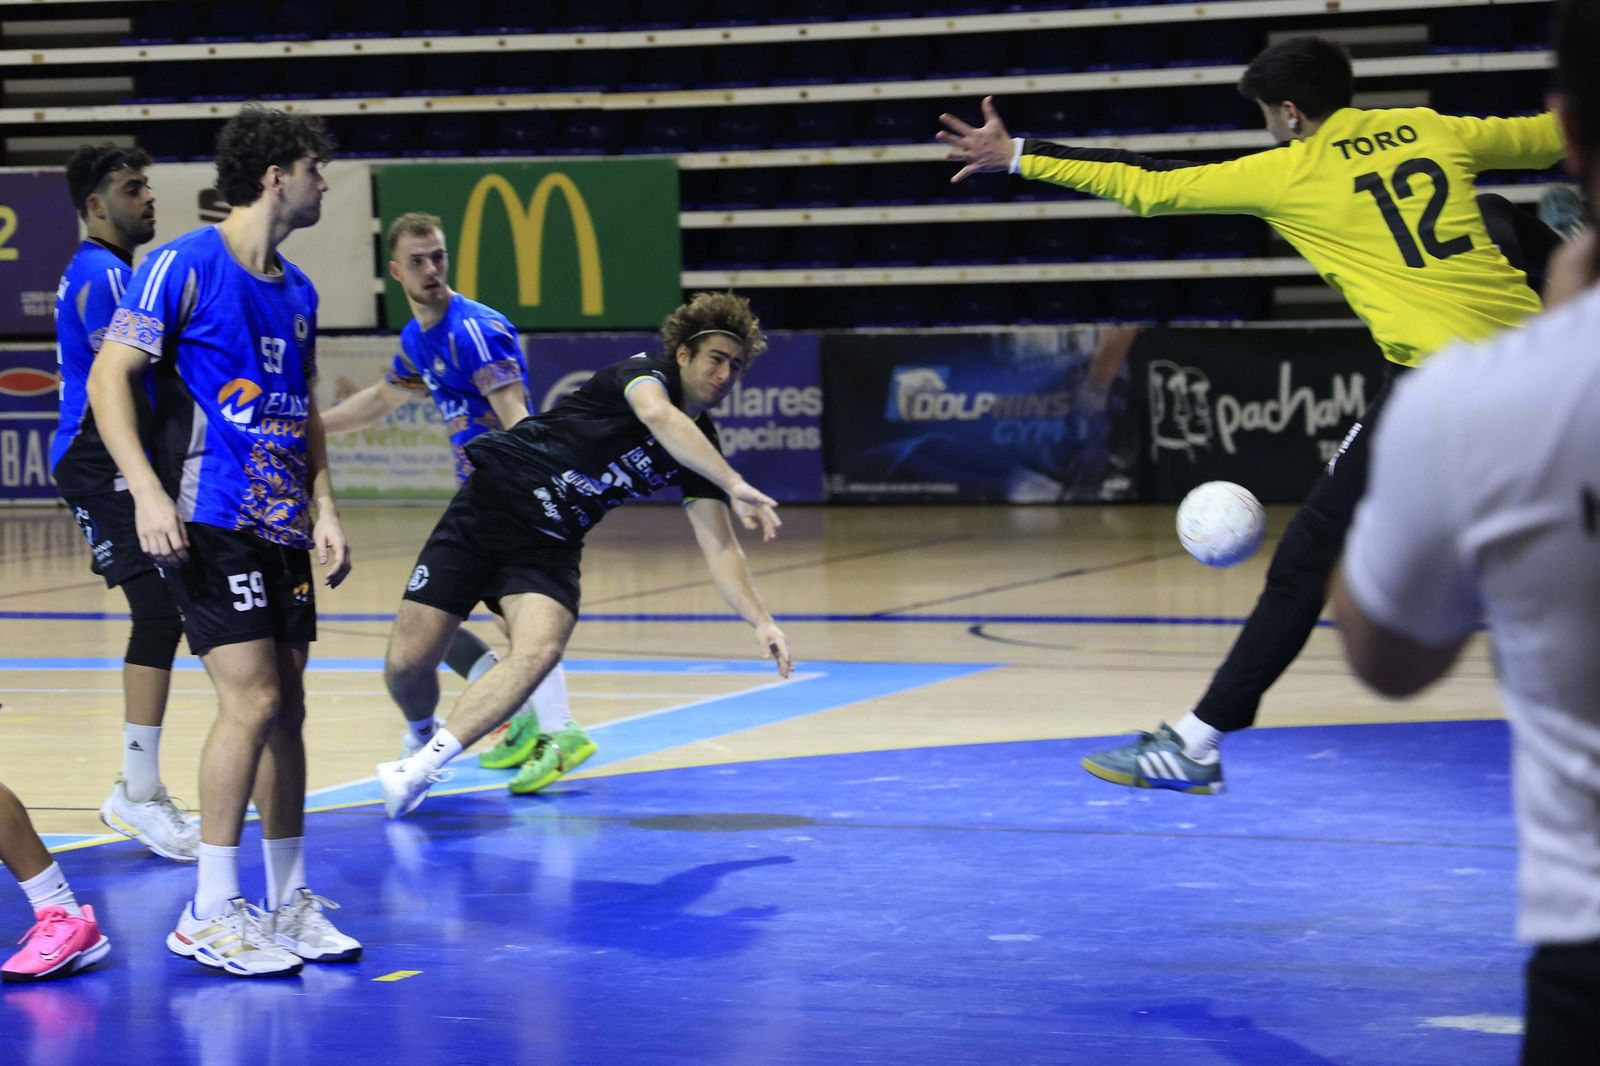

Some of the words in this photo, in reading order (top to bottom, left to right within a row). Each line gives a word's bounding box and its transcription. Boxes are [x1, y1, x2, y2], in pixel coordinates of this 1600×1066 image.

[1331, 125, 1418, 160] TORO
[1354, 157, 1475, 269] 12
[260, 336, 287, 374] 59
[910, 391, 1072, 422] DOLPHINS
[993, 419, 1067, 447] GYM
[227, 570, 268, 612] 59
